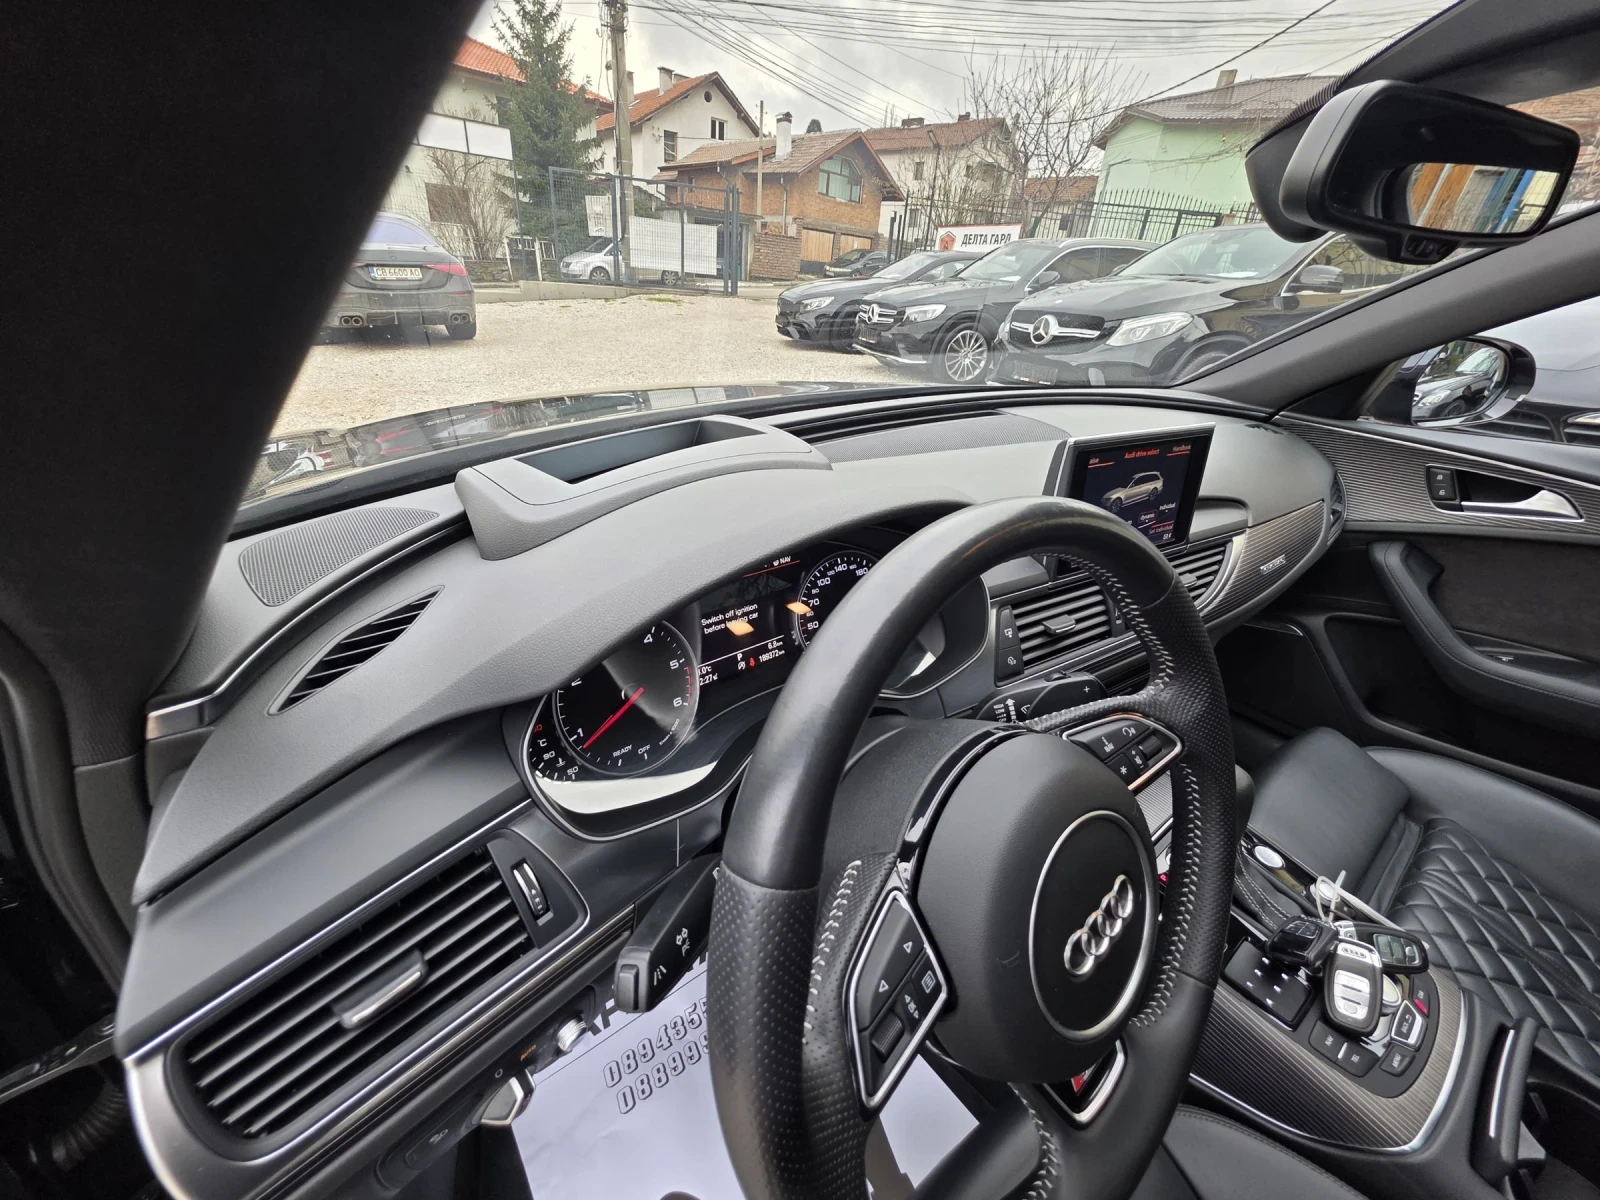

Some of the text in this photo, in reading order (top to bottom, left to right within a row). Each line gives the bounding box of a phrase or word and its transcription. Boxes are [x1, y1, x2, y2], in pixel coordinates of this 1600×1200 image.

[961, 233, 988, 247] ДЕЛТА
[389, 268, 409, 277] 6600
[834, 563, 848, 573] 140
[855, 567, 868, 577] 180
[817, 577, 831, 587] 100
[808, 598, 820, 607] 70
[701, 603, 758, 626] Switch off ignition
[704, 622, 726, 635] before
[748, 611, 759, 620] car
[807, 621, 819, 630] 50
[643, 634, 653, 643] 4
[737, 653, 743, 661] P
[669, 659, 679, 669] 5
[673, 697, 682, 707] 6
[577, 727, 584, 738] 1
[613, 744, 633, 758] READY
[637, 744, 651, 755] OFF
[1324, 1034, 1334, 1047] NAV
